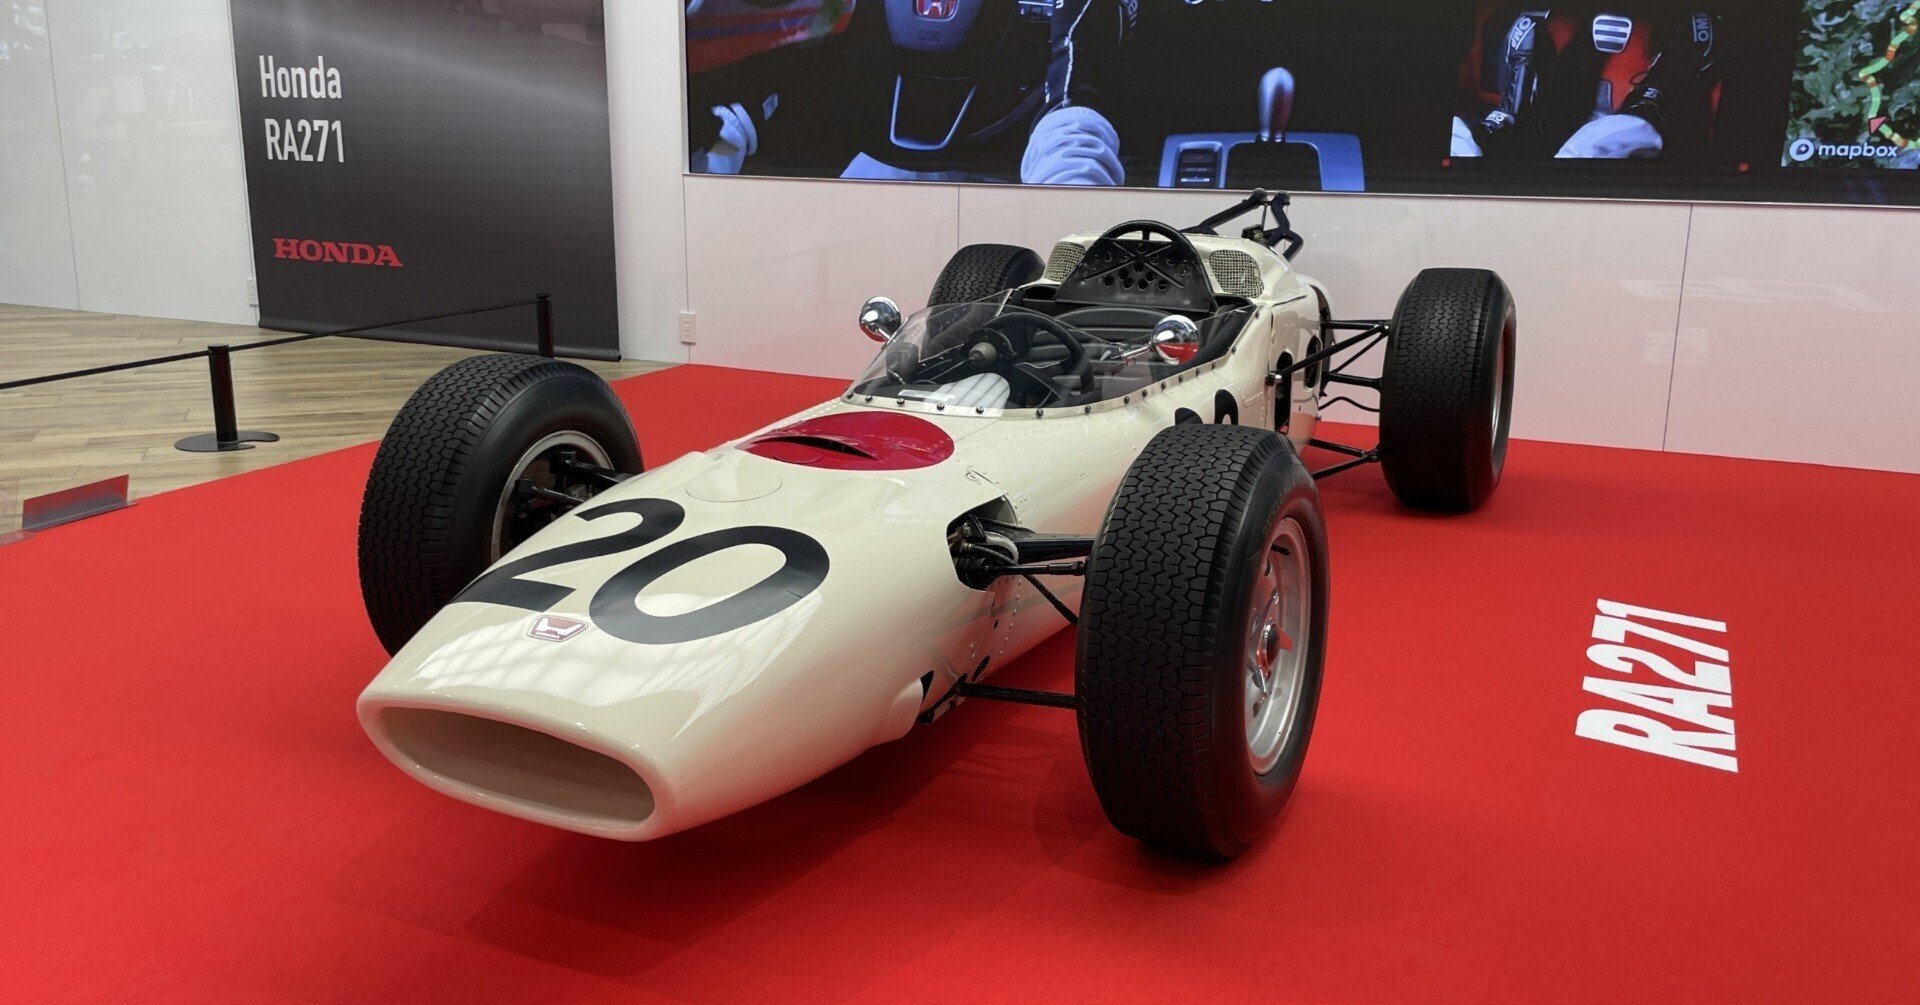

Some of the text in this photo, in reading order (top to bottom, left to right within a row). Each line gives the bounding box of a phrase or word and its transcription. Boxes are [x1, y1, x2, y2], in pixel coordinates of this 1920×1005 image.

[258, 54, 342, 99] Honda
[264, 118, 345, 163] RA271
[1818, 142, 1898, 160] mapbox
[273, 238, 403, 267] HONDA
[449, 497, 831, 645] 20
[1575, 598, 1739, 773] RA271
